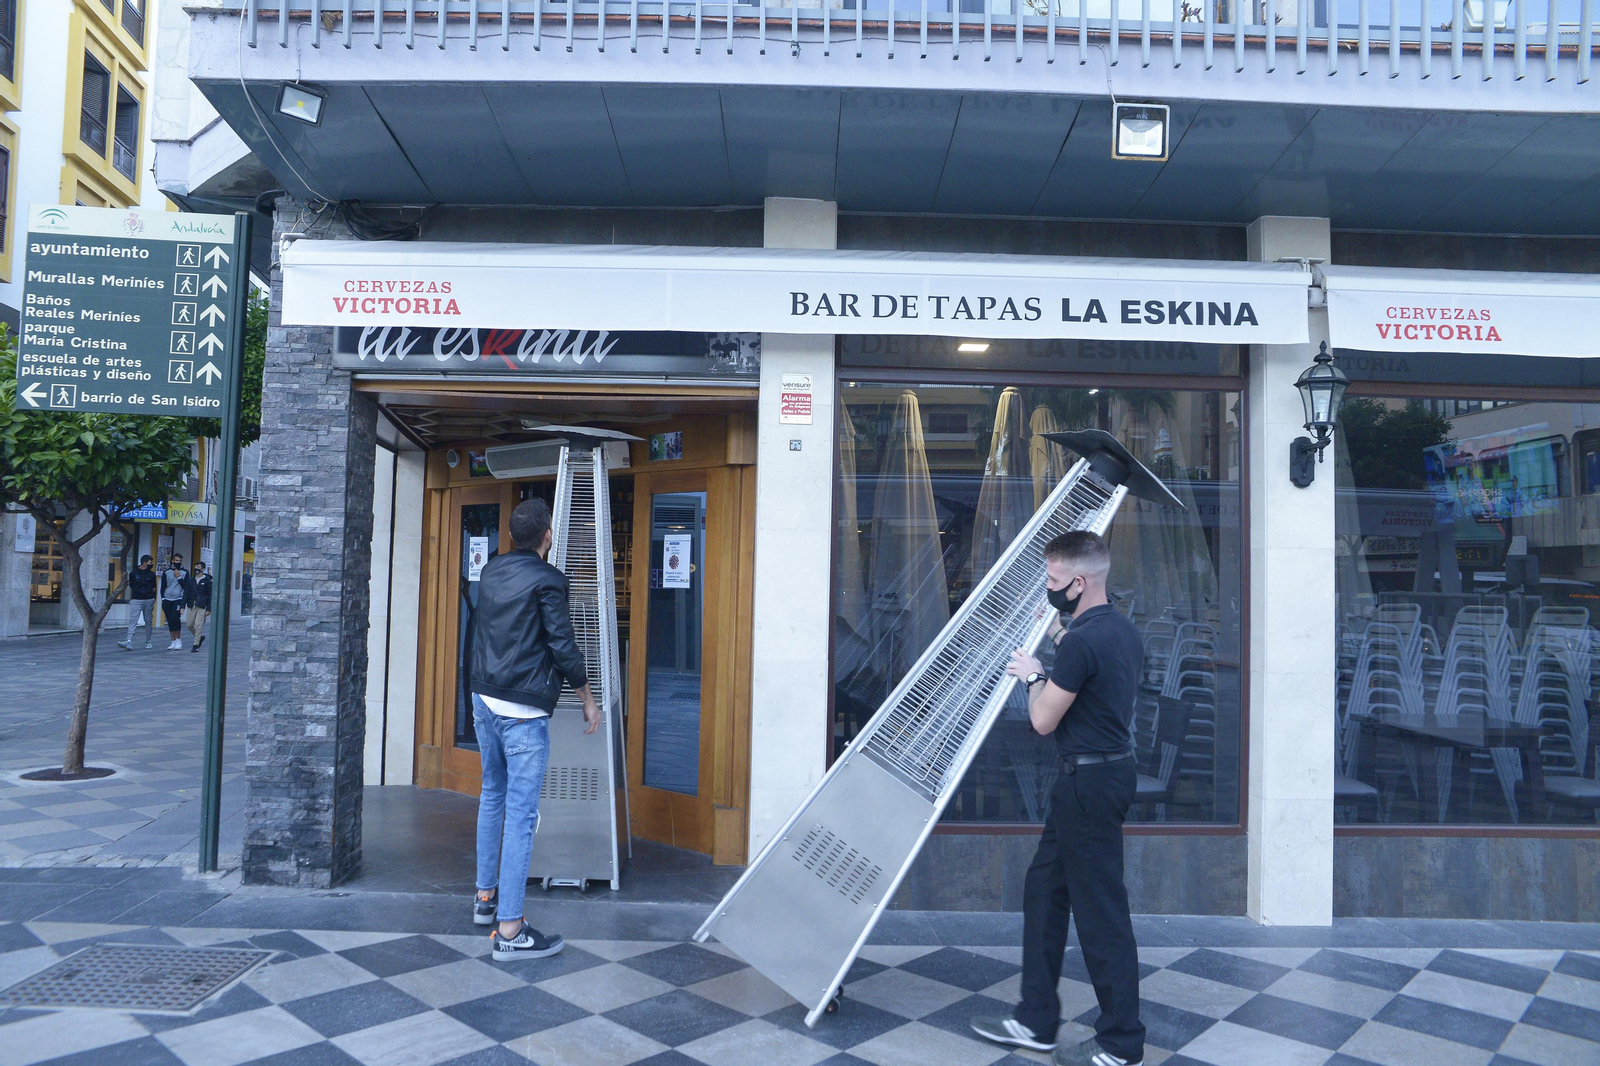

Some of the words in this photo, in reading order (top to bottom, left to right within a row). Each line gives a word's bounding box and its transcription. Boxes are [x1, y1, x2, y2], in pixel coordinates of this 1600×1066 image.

[170, 220, 227, 236] Andalucía
[30, 243, 150, 259] ayuntamiento
[28, 270, 95, 286] Murallas
[101, 275, 165, 289] Meriníes
[344, 280, 452, 294] CERVEZAS
[26, 293, 71, 307] Baños
[332, 297, 461, 315] VICTORIA
[25, 306, 75, 320] Reales
[80, 309, 141, 323] Meriníes
[790, 292, 861, 317] BAR
[872, 294, 919, 319] DE
[928, 295, 1042, 321] TAPAS
[1061, 297, 1108, 323] LA
[1121, 300, 1259, 326] ESKINA
[1386, 306, 1491, 321] CERVEZAS
[24, 323, 75, 335] parque
[1375, 323, 1502, 342] VICTORIA
[23, 334, 64, 347] María
[71, 337, 127, 351] Cristina
[22, 353, 77, 365] escuela
[82, 355, 100, 365] de
[105, 357, 142, 368] artes
[21, 364, 87, 378] plásticas
[93, 370, 102, 380] y
[106, 368, 152, 381] diseño
[80, 392, 123, 404] barrio
[128, 394, 146, 405] de
[151, 395, 178, 406] San
[183, 396, 220, 408] Isidro
[782, 394, 811, 402] Alarma
